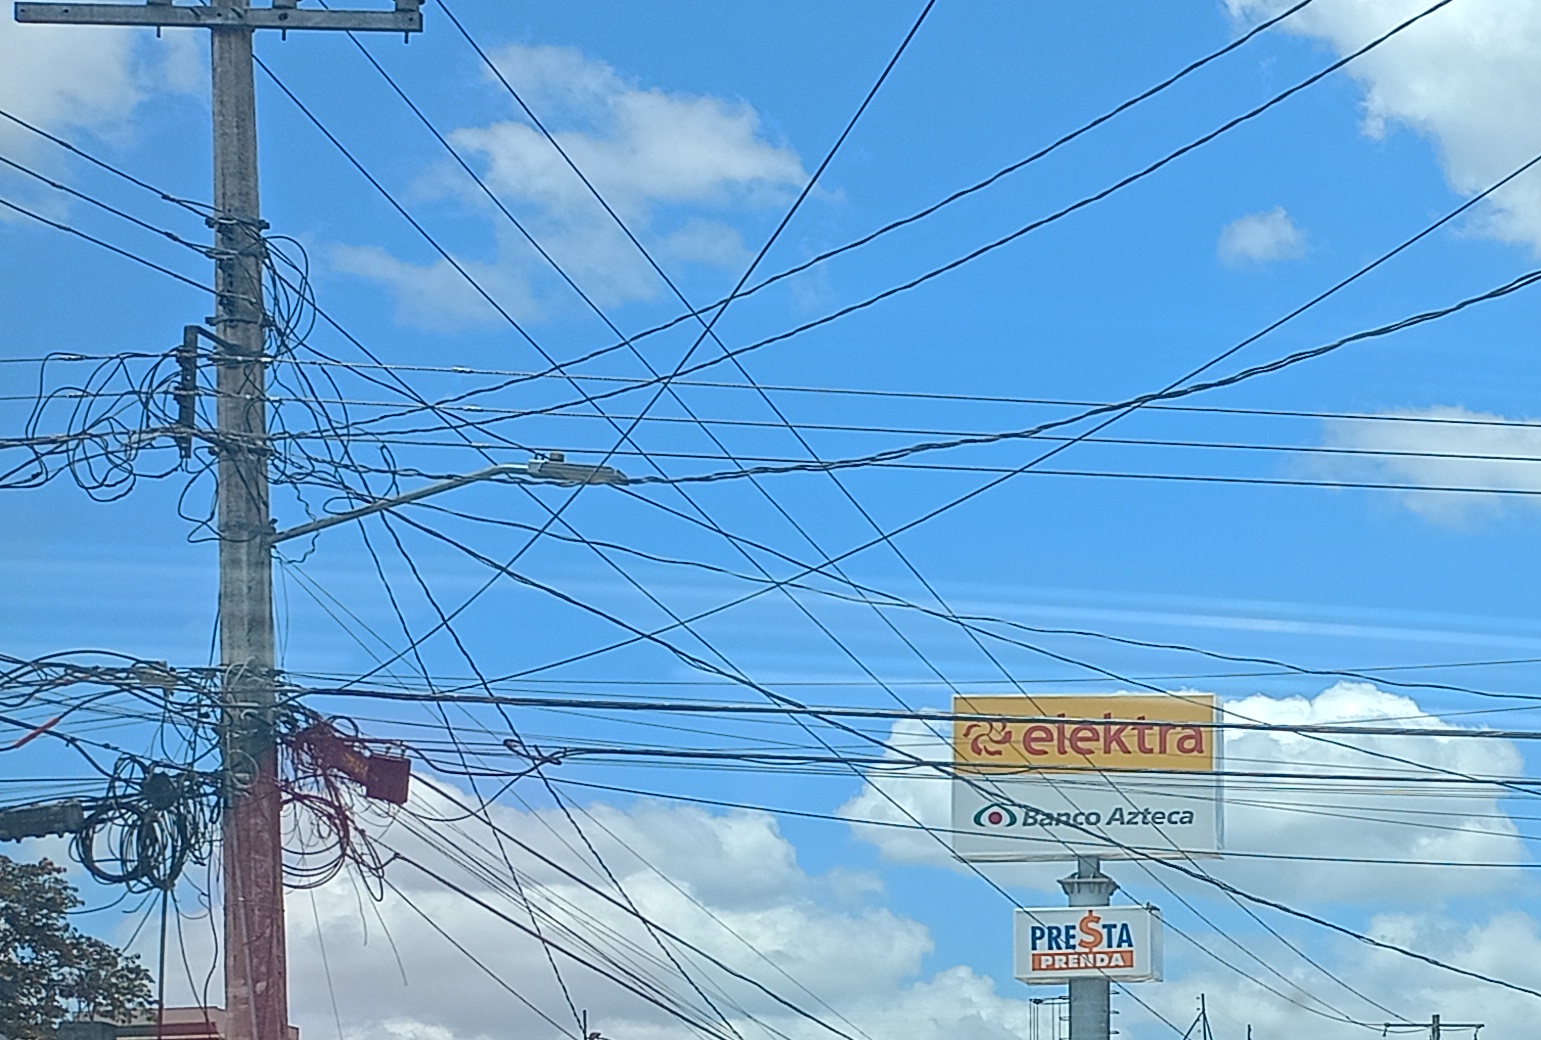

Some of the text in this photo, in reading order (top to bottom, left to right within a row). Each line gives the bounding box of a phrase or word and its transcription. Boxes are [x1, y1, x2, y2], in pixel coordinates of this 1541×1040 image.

[1022, 713, 1205, 756] elektra
[1021, 807, 1195, 827] Banco Azteca
[1040, 953, 1125, 969] PRENDA
